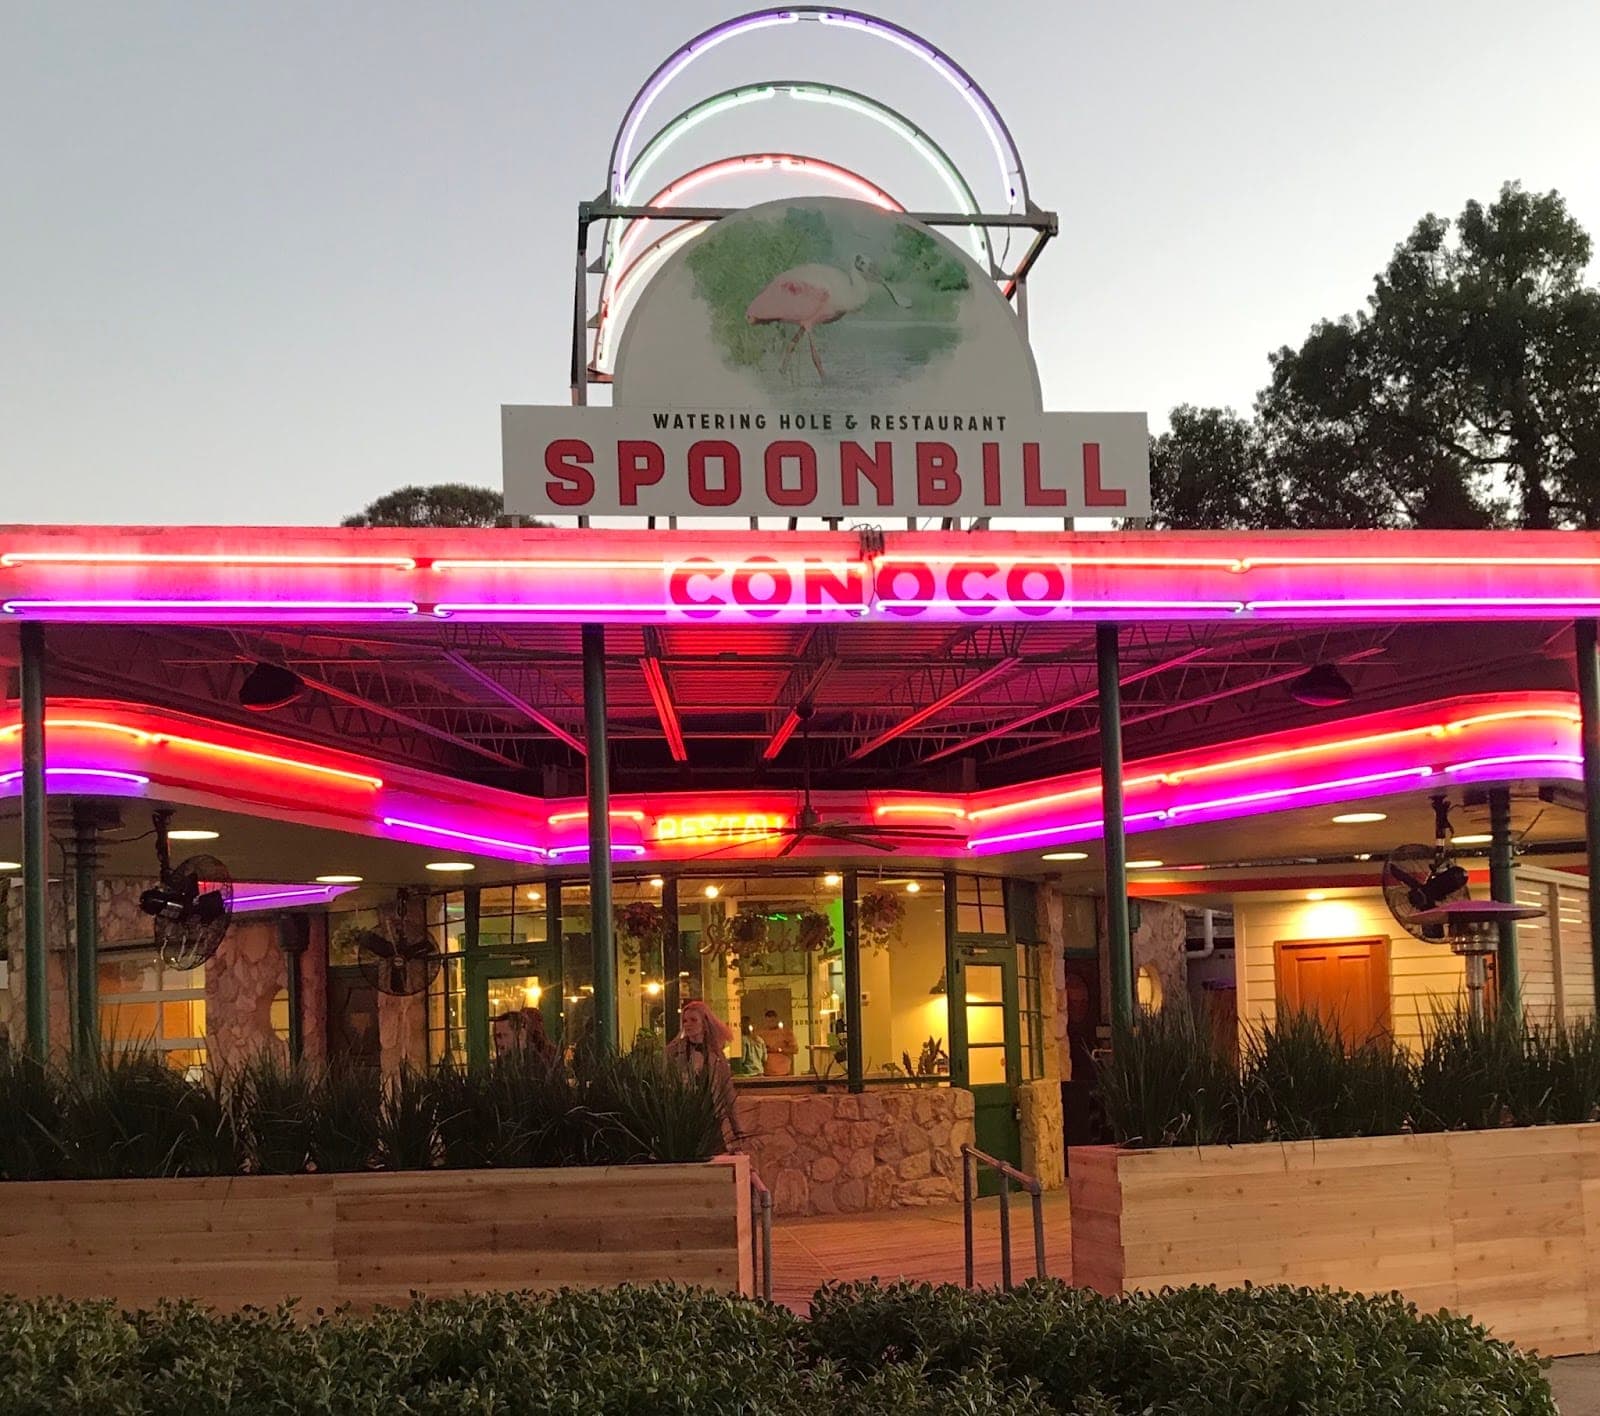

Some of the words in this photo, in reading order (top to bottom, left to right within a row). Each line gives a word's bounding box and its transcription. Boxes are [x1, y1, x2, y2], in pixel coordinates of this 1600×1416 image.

[653, 413, 767, 430] WATERING
[780, 413, 832, 430] HOLE
[845, 414, 858, 430] &
[871, 414, 1007, 432] RESTAURANT
[545, 439, 1127, 507] SPOONBILL
[669, 556, 1066, 619] CONOCO
